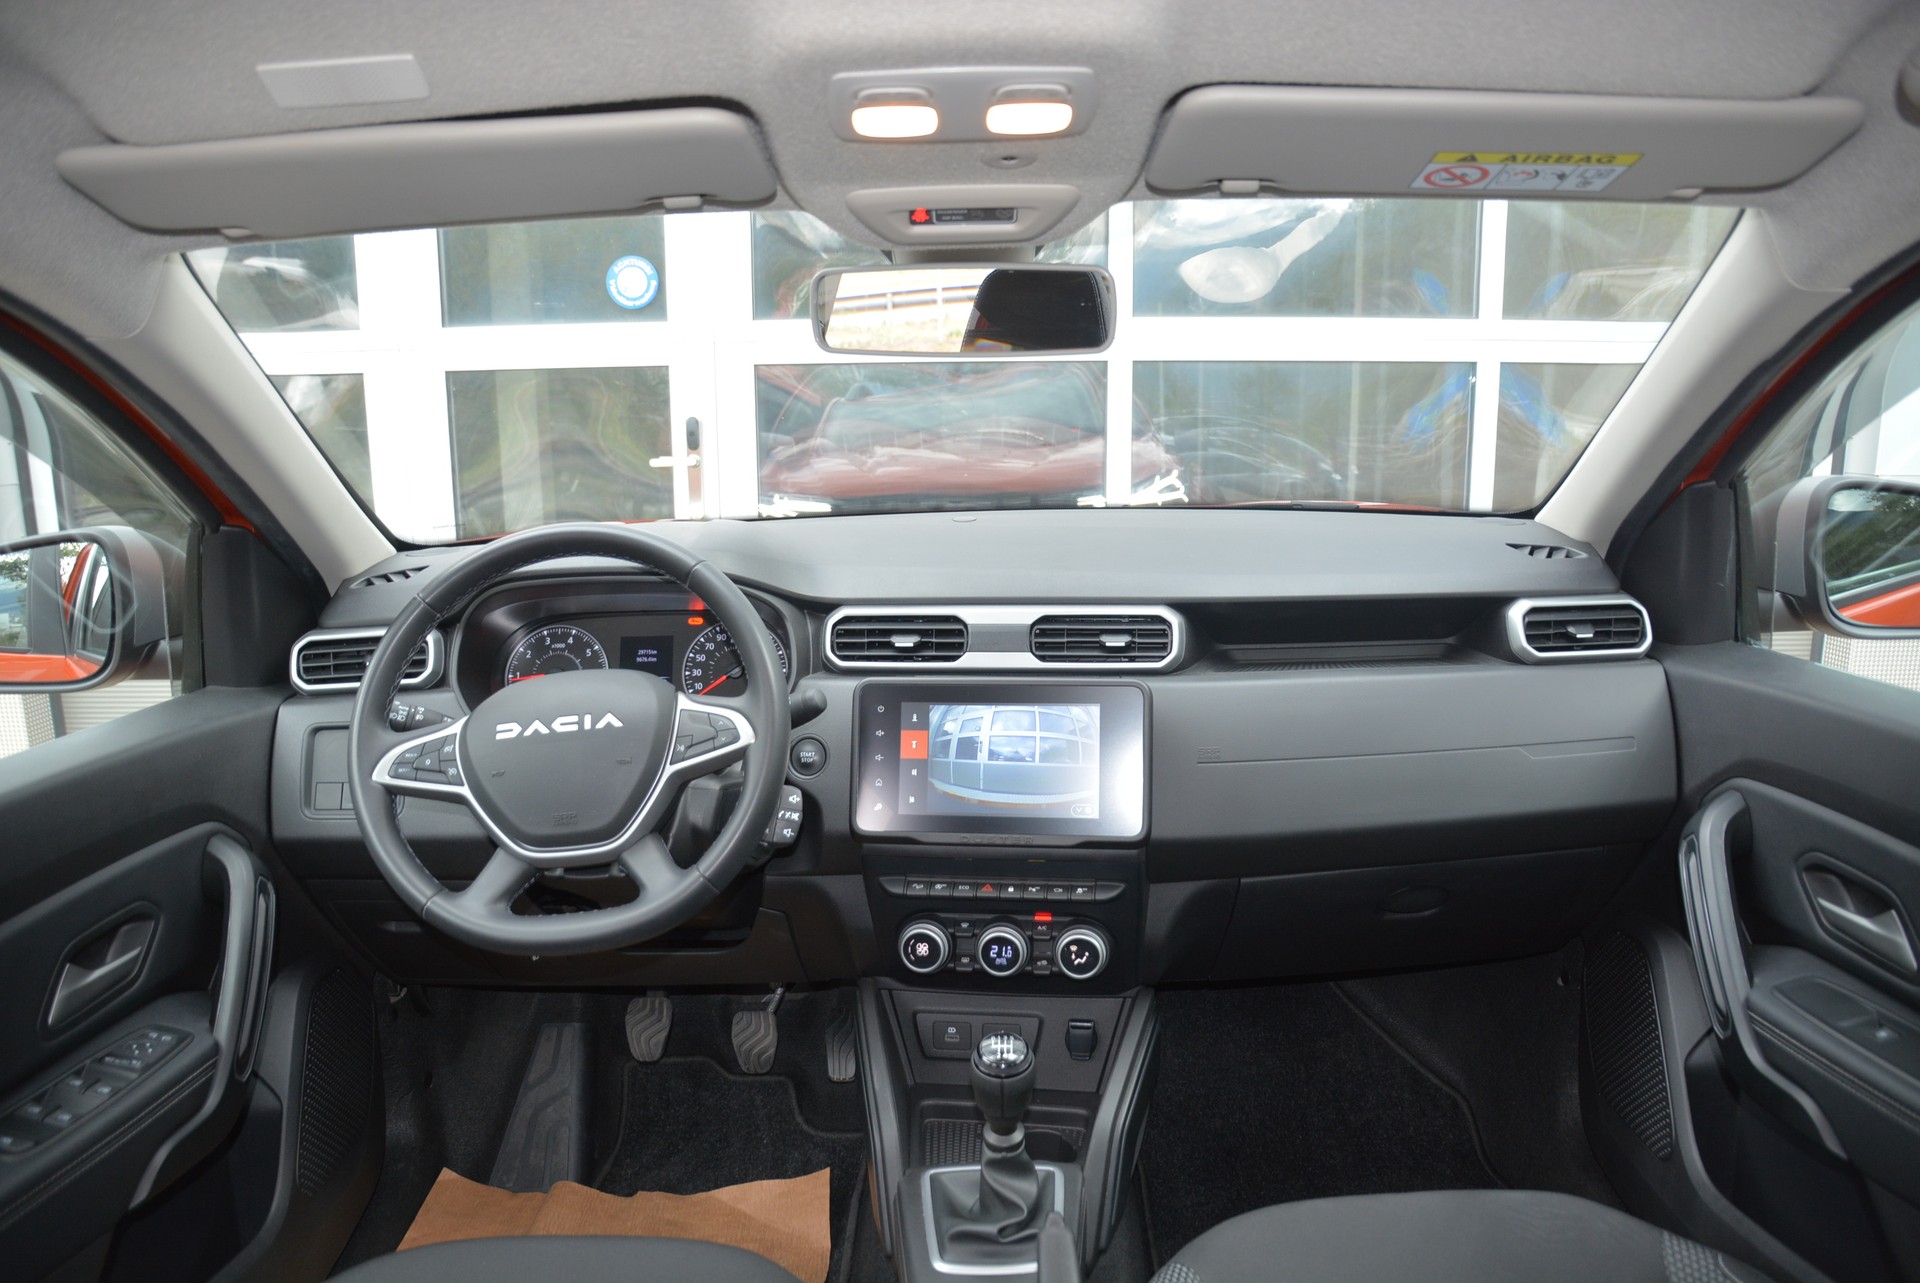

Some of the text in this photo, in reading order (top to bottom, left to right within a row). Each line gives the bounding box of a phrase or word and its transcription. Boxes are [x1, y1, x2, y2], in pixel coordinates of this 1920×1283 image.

[1500, 154, 1618, 164] AIRBAG
[544, 637, 551, 645] 3
[567, 636, 574, 645] 4
[716, 633, 727, 641] 90
[705, 642, 715, 650] 70
[525, 650, 532, 658] 2
[585, 648, 592, 657] 5
[695, 654, 706, 662] 50
[516, 671, 520, 679] 1
[691, 668, 702, 676] 30
[694, 682, 703, 690] 10
[495, 712, 624, 740] DACIA
